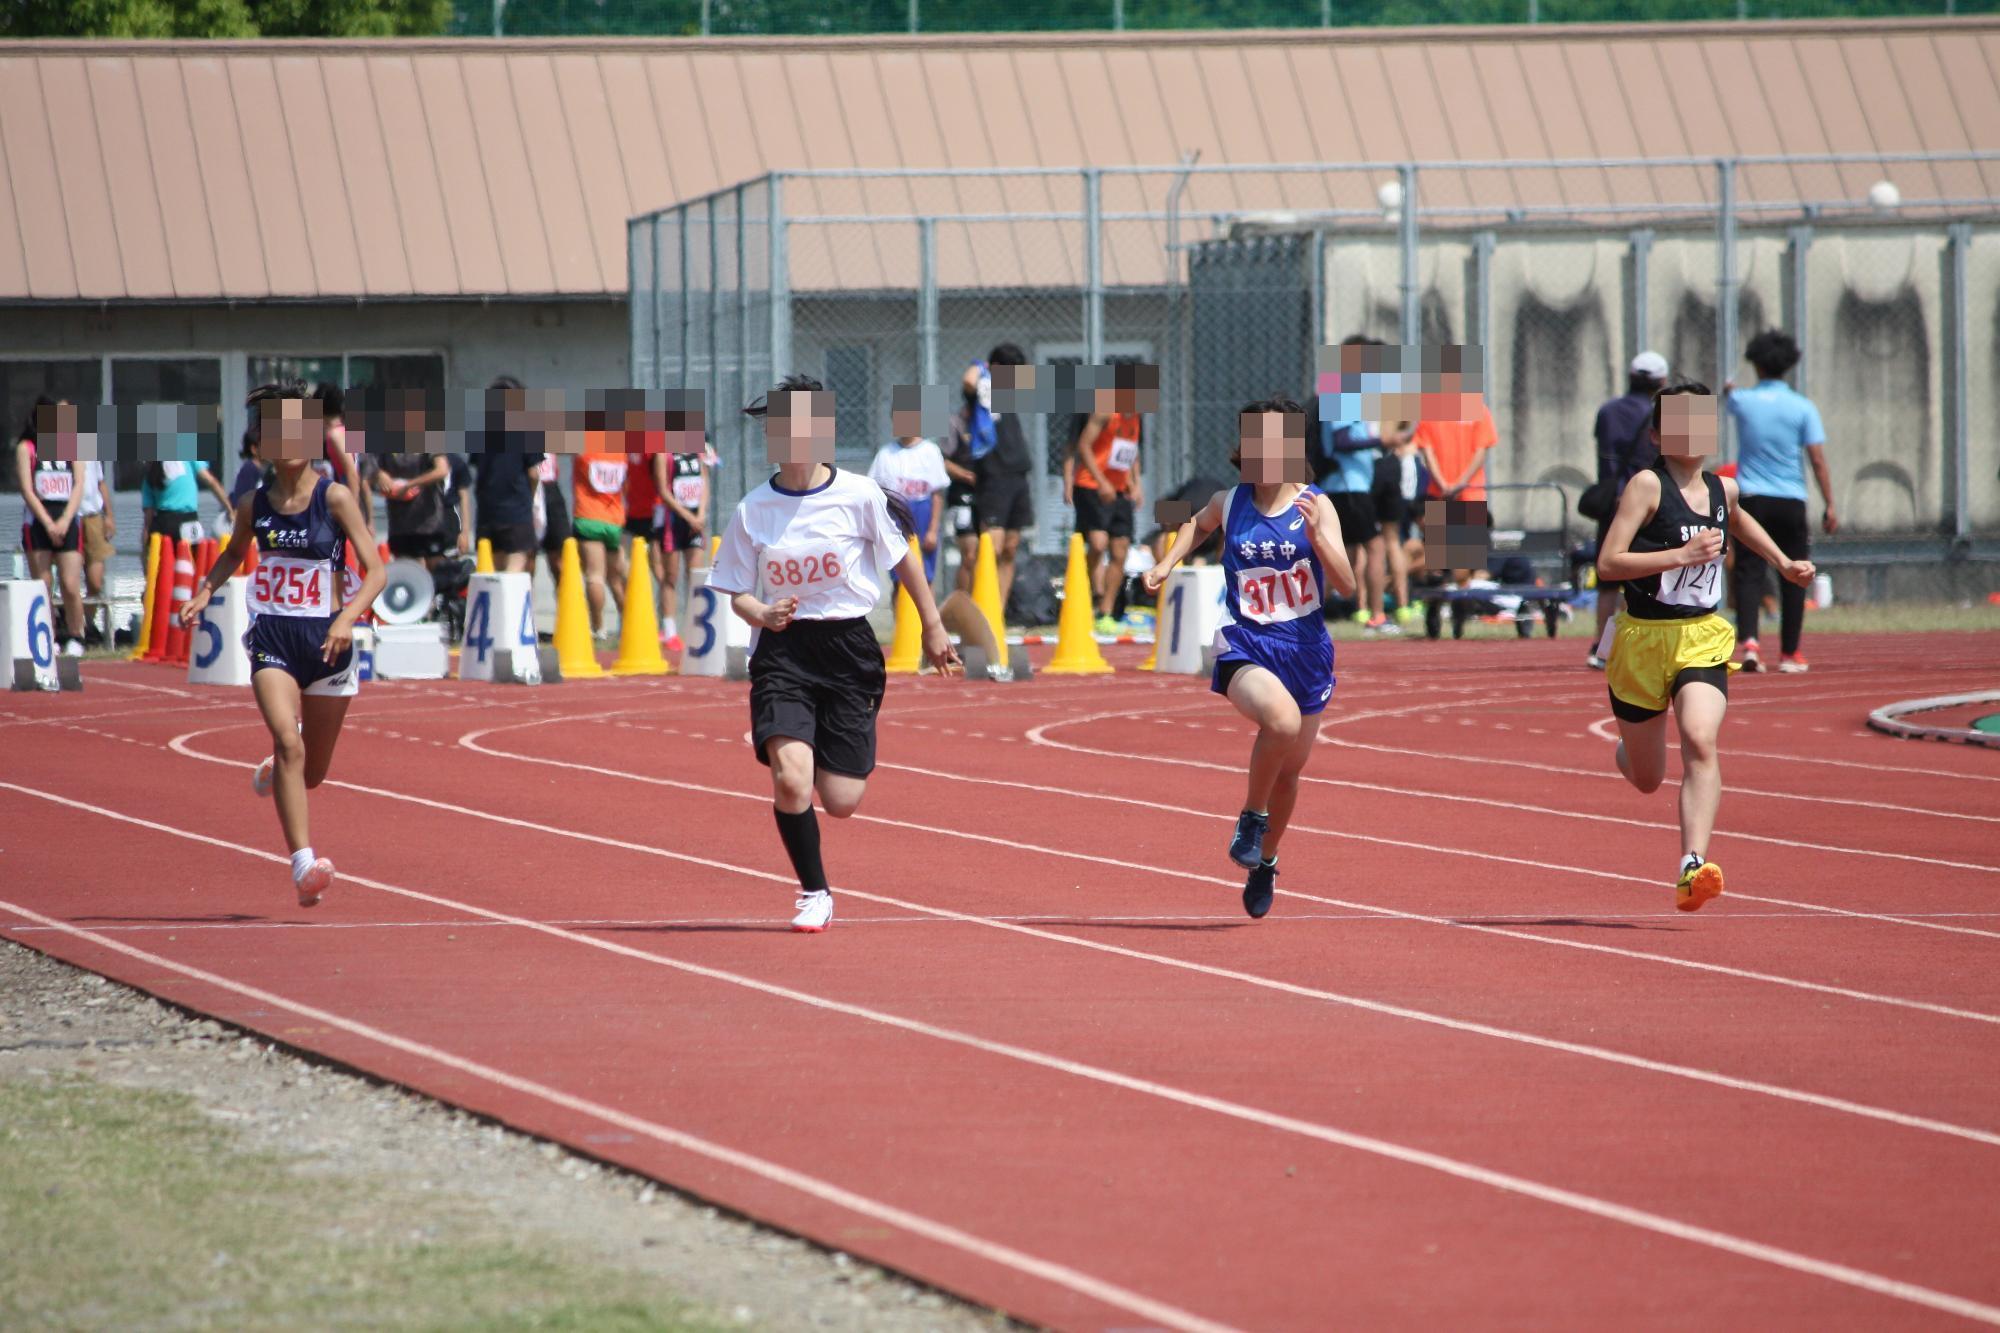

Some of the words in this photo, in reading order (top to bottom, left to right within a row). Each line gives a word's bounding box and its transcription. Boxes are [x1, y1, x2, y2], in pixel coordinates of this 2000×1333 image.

[277, 539, 309, 548] CLUB
[767, 552, 841, 586] 3826
[255, 565, 320, 606] 5254
[1168, 585, 1184, 656] 1
[1244, 568, 1313, 615] 3712
[28, 595, 53, 668] 6
[195, 596, 224, 668] 5
[467, 592, 494, 662] 4
[688, 586, 716, 658] 3
